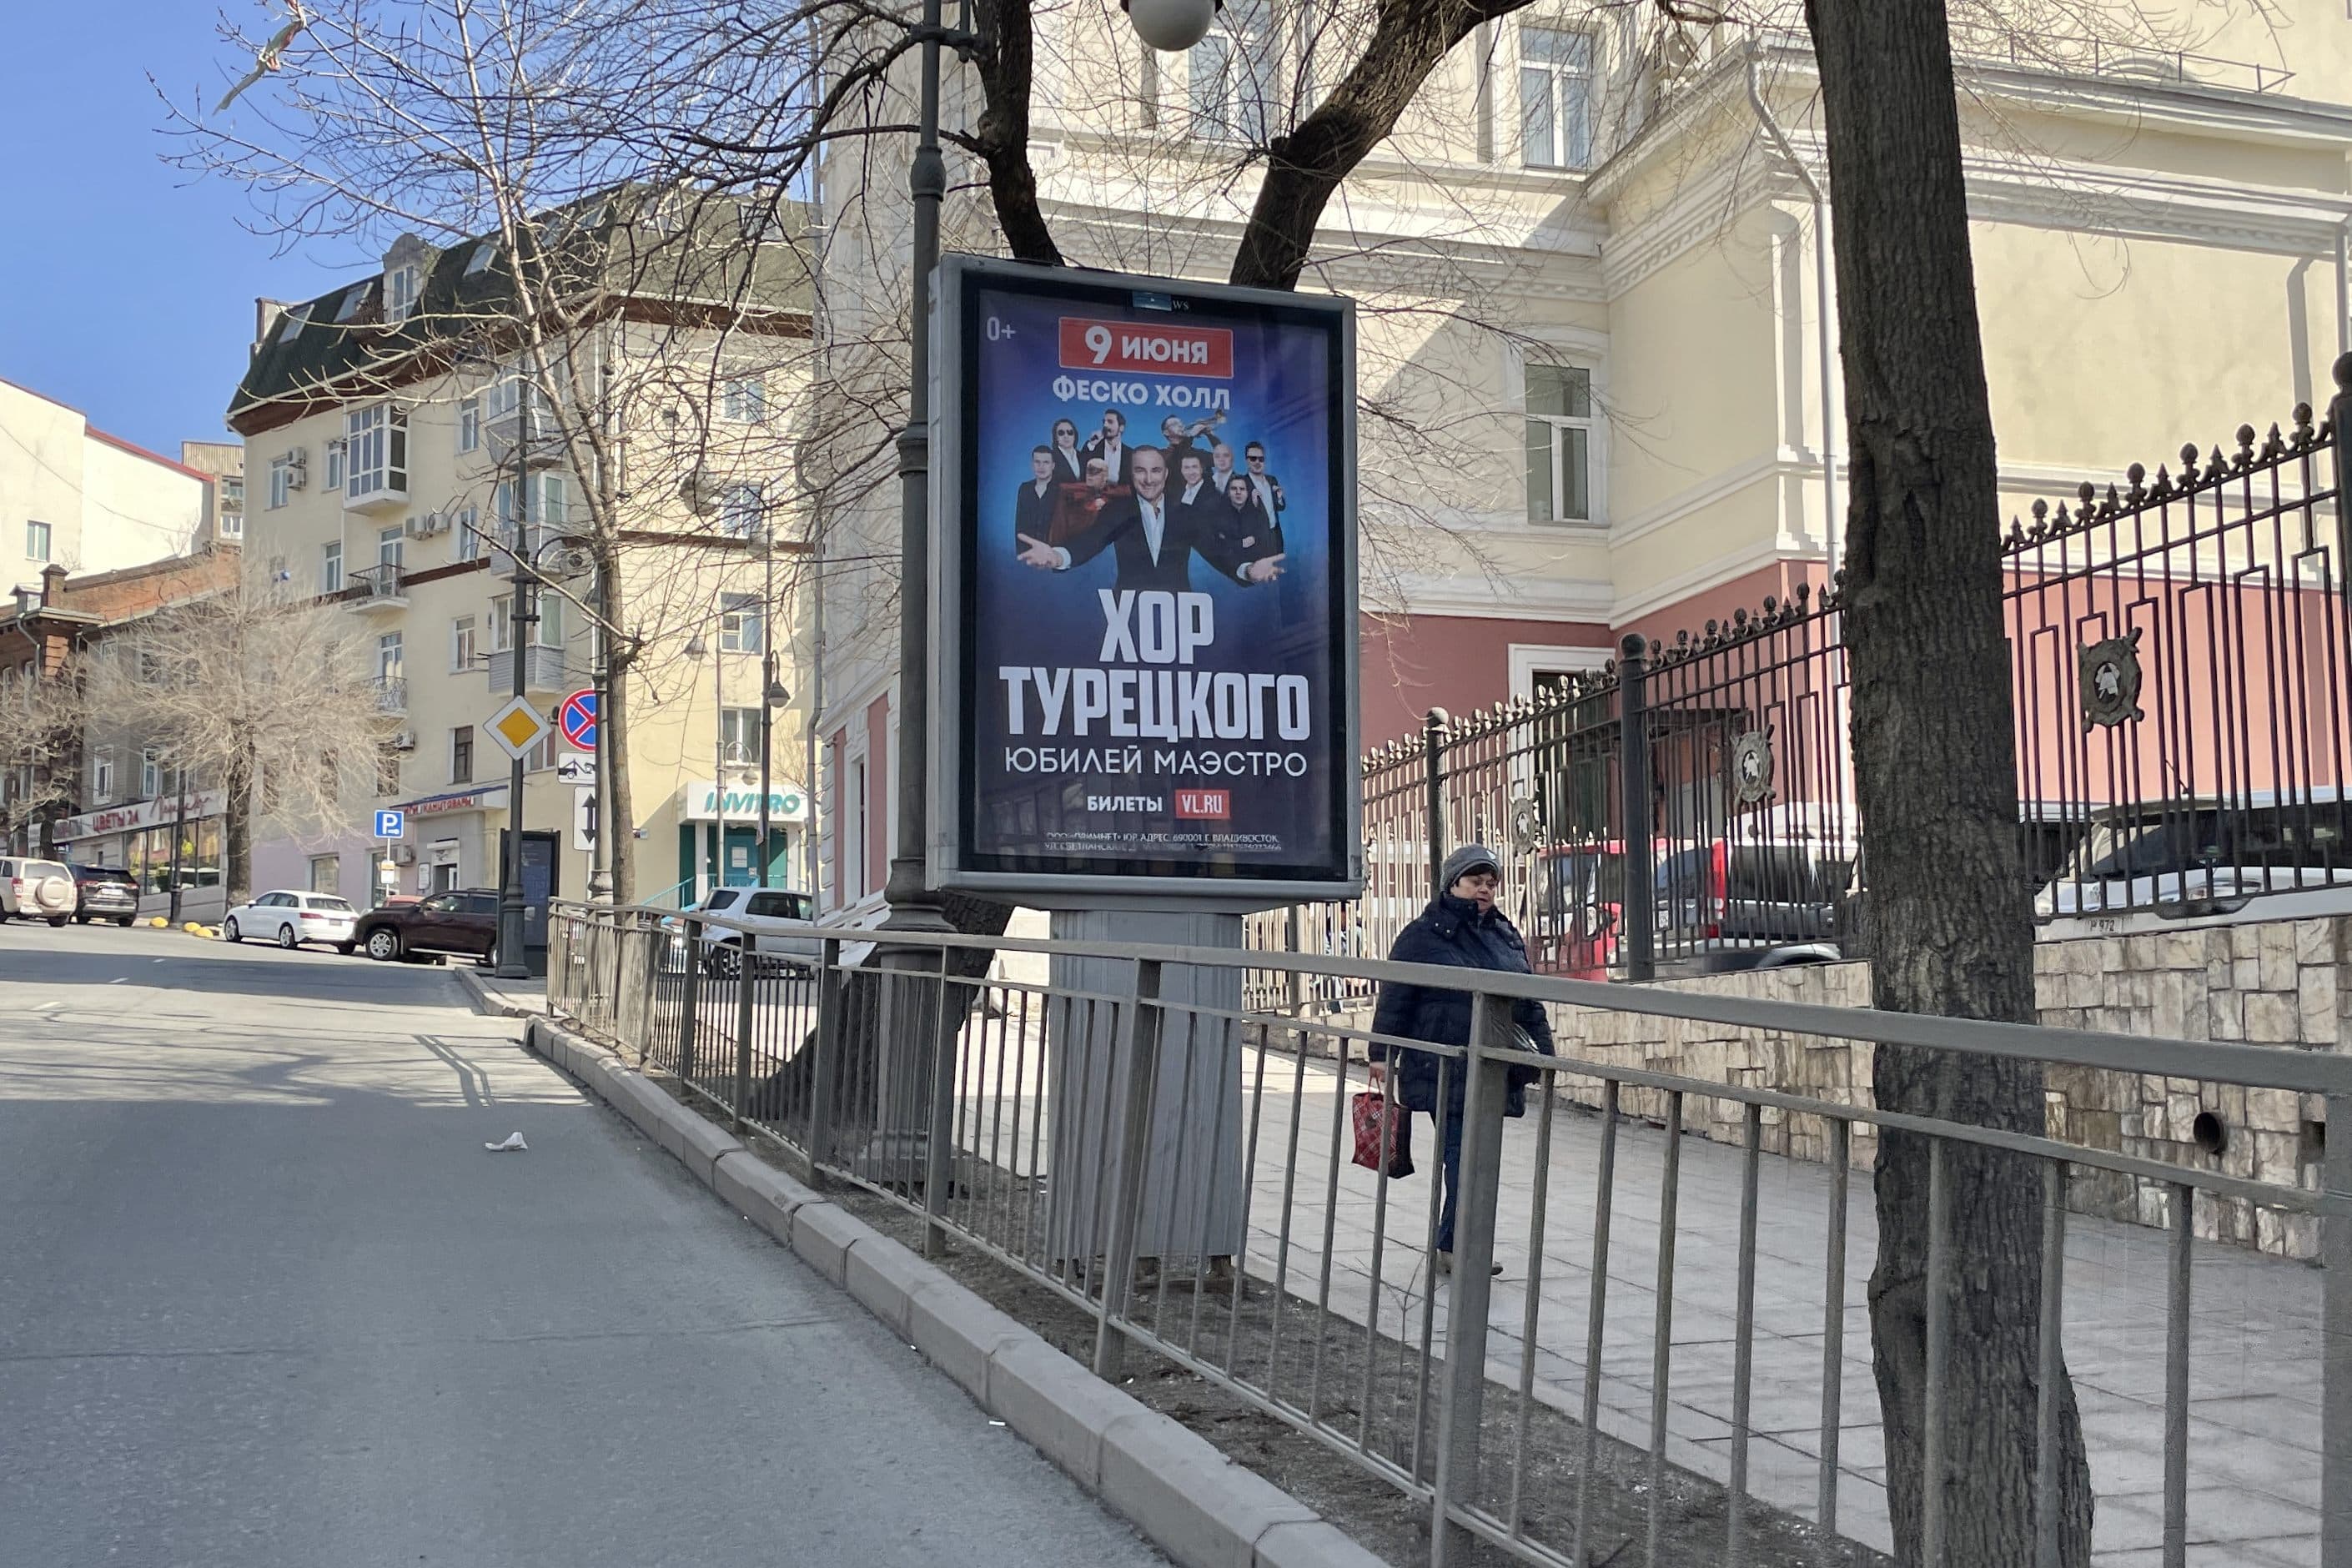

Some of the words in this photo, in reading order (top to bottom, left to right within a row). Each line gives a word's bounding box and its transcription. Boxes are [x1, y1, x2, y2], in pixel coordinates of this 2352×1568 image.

[986, 316, 1017, 341] 0+
[1085, 325, 1113, 364] 9
[1122, 335, 1209, 364] ИЮНЯ
[1053, 374, 1148, 405] ФЕСКО
[1154, 384, 1231, 410] ХОЛЛ
[1098, 588, 1215, 664] ХОР
[998, 666, 1310, 742] ТУРЕЦКОГО
[1004, 745, 1143, 774] ЮБИЛЕЙ
[1154, 750, 1308, 777] МАЭСТРО
[1087, 795, 1163, 812] БИЛЕТЫ
[1181, 794, 1223, 813] VL.RU
